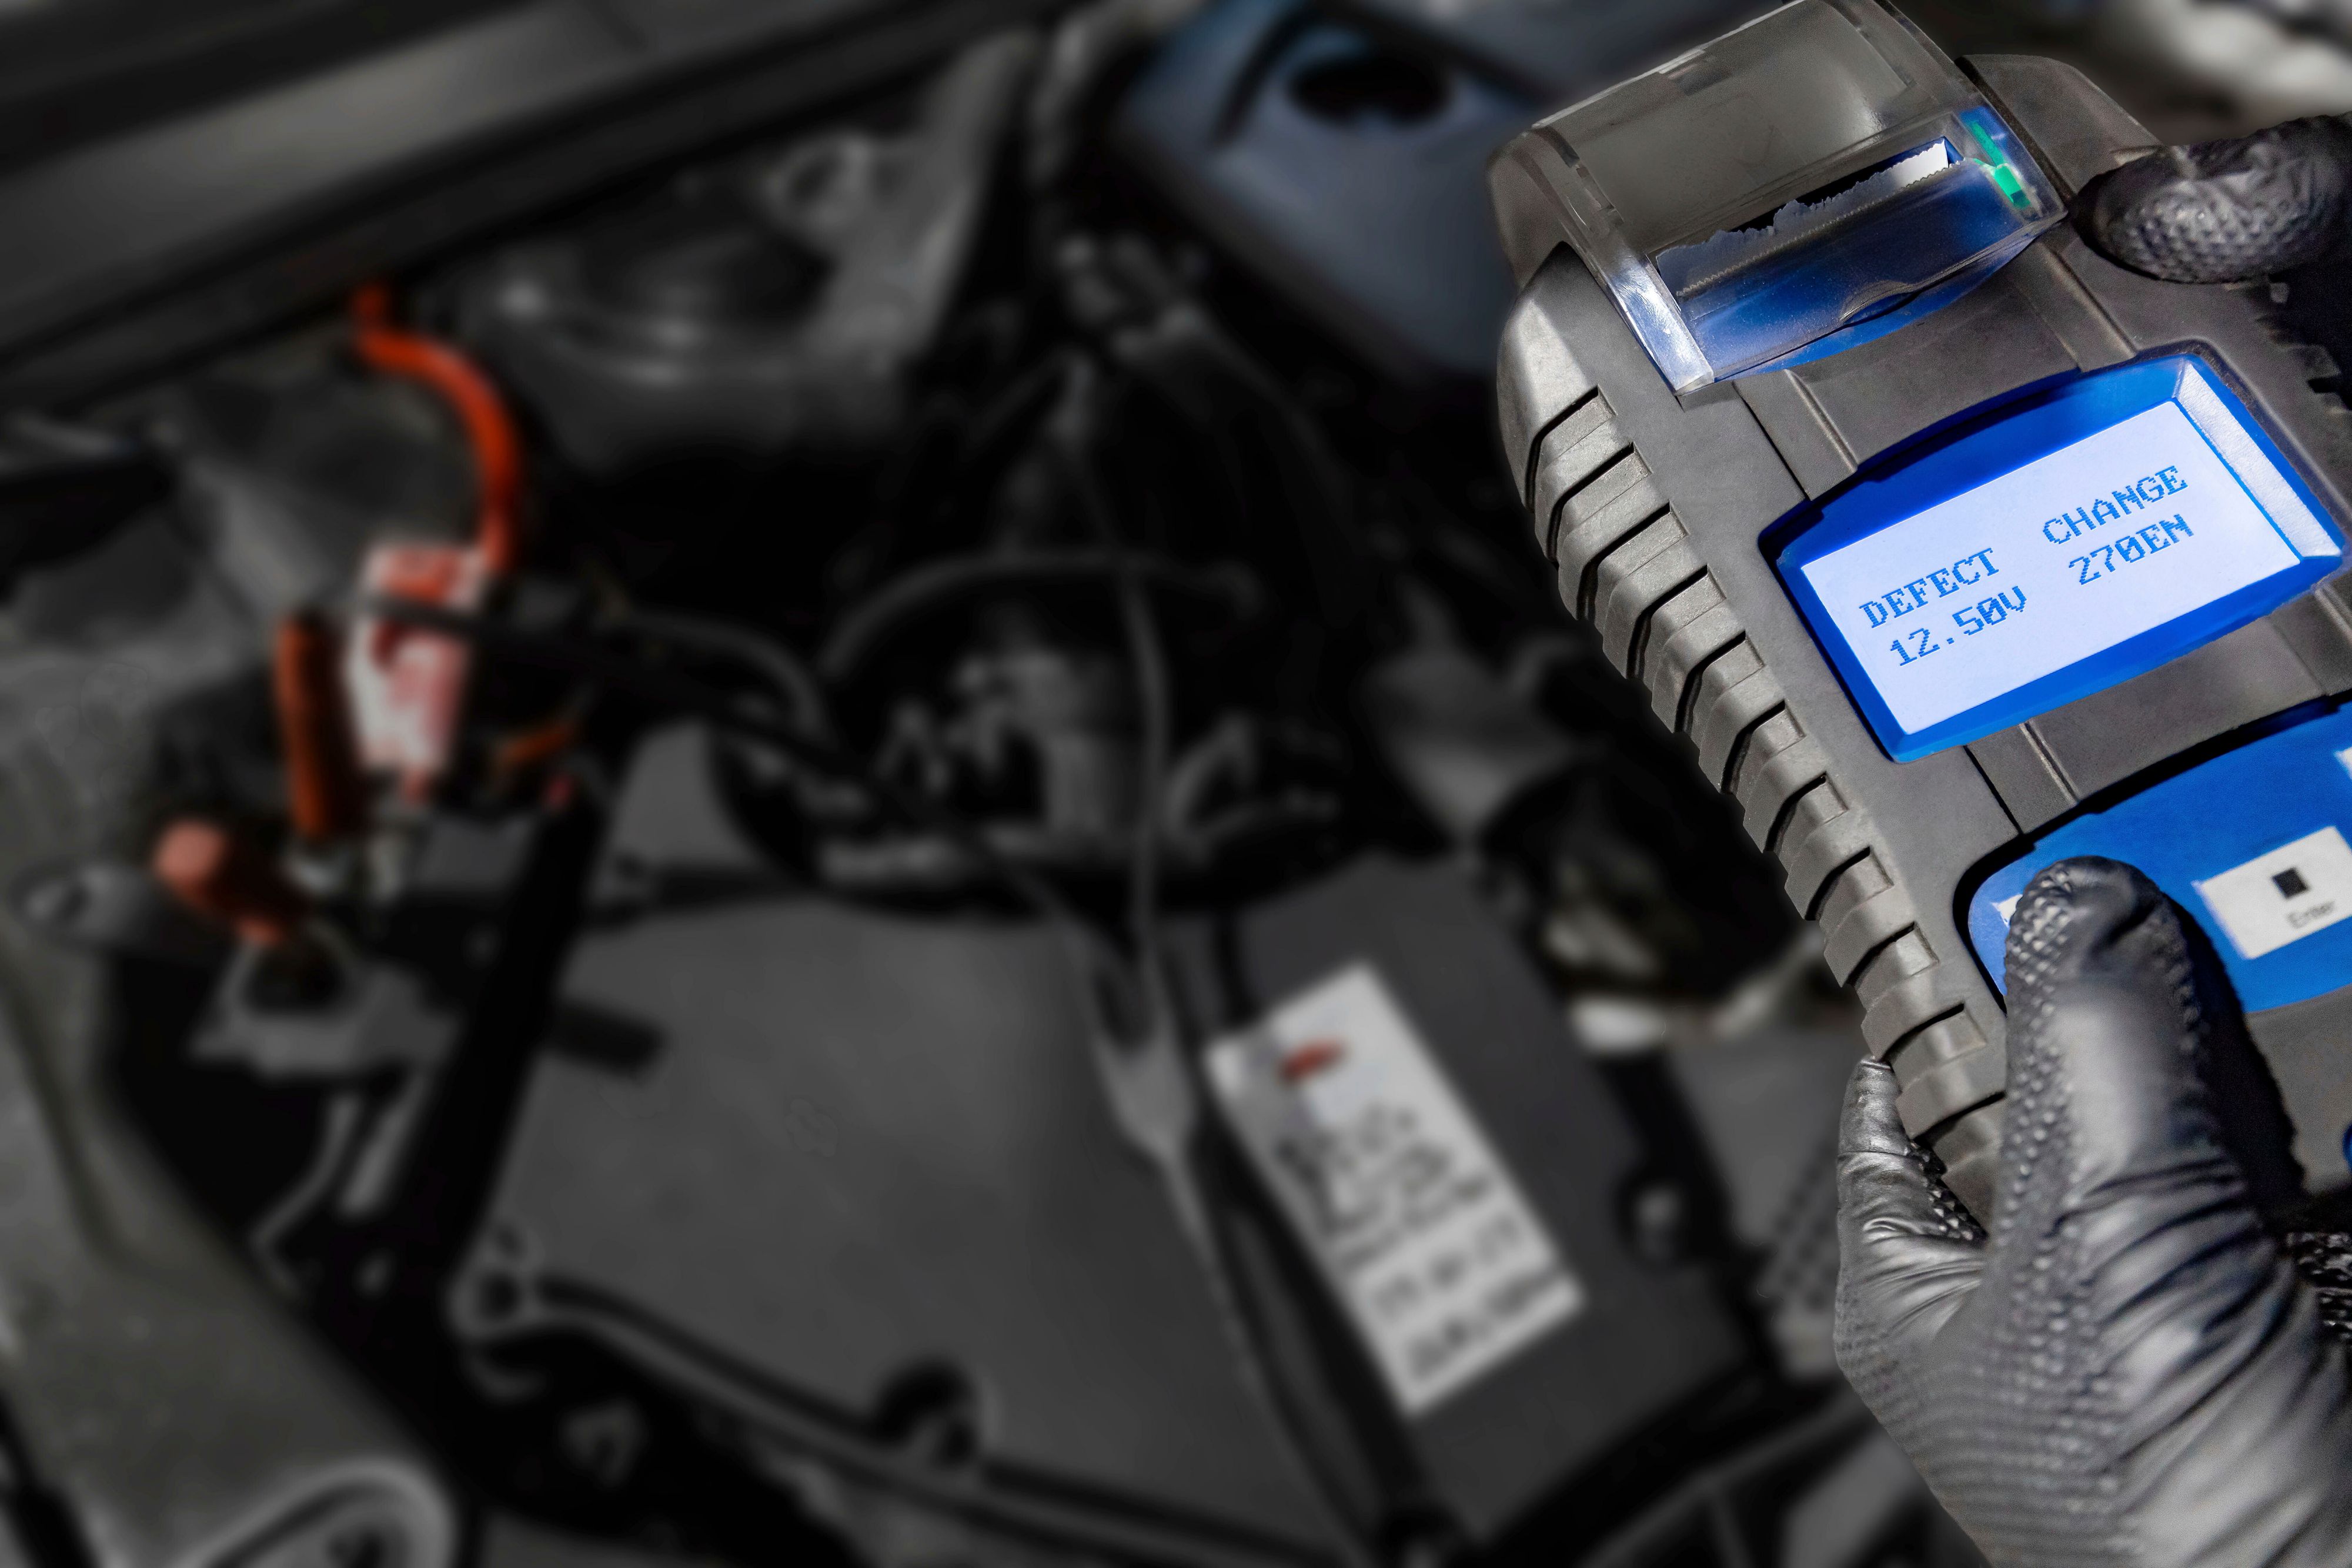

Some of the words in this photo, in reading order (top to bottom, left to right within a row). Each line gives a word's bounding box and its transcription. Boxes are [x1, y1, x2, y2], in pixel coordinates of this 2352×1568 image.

[1859, 548, 1999, 628] DEFECT
[2043, 466, 2188, 544] CHANGE
[1890, 586, 2027, 666] 12.50V
[2069, 514, 2193, 585] 270EN
